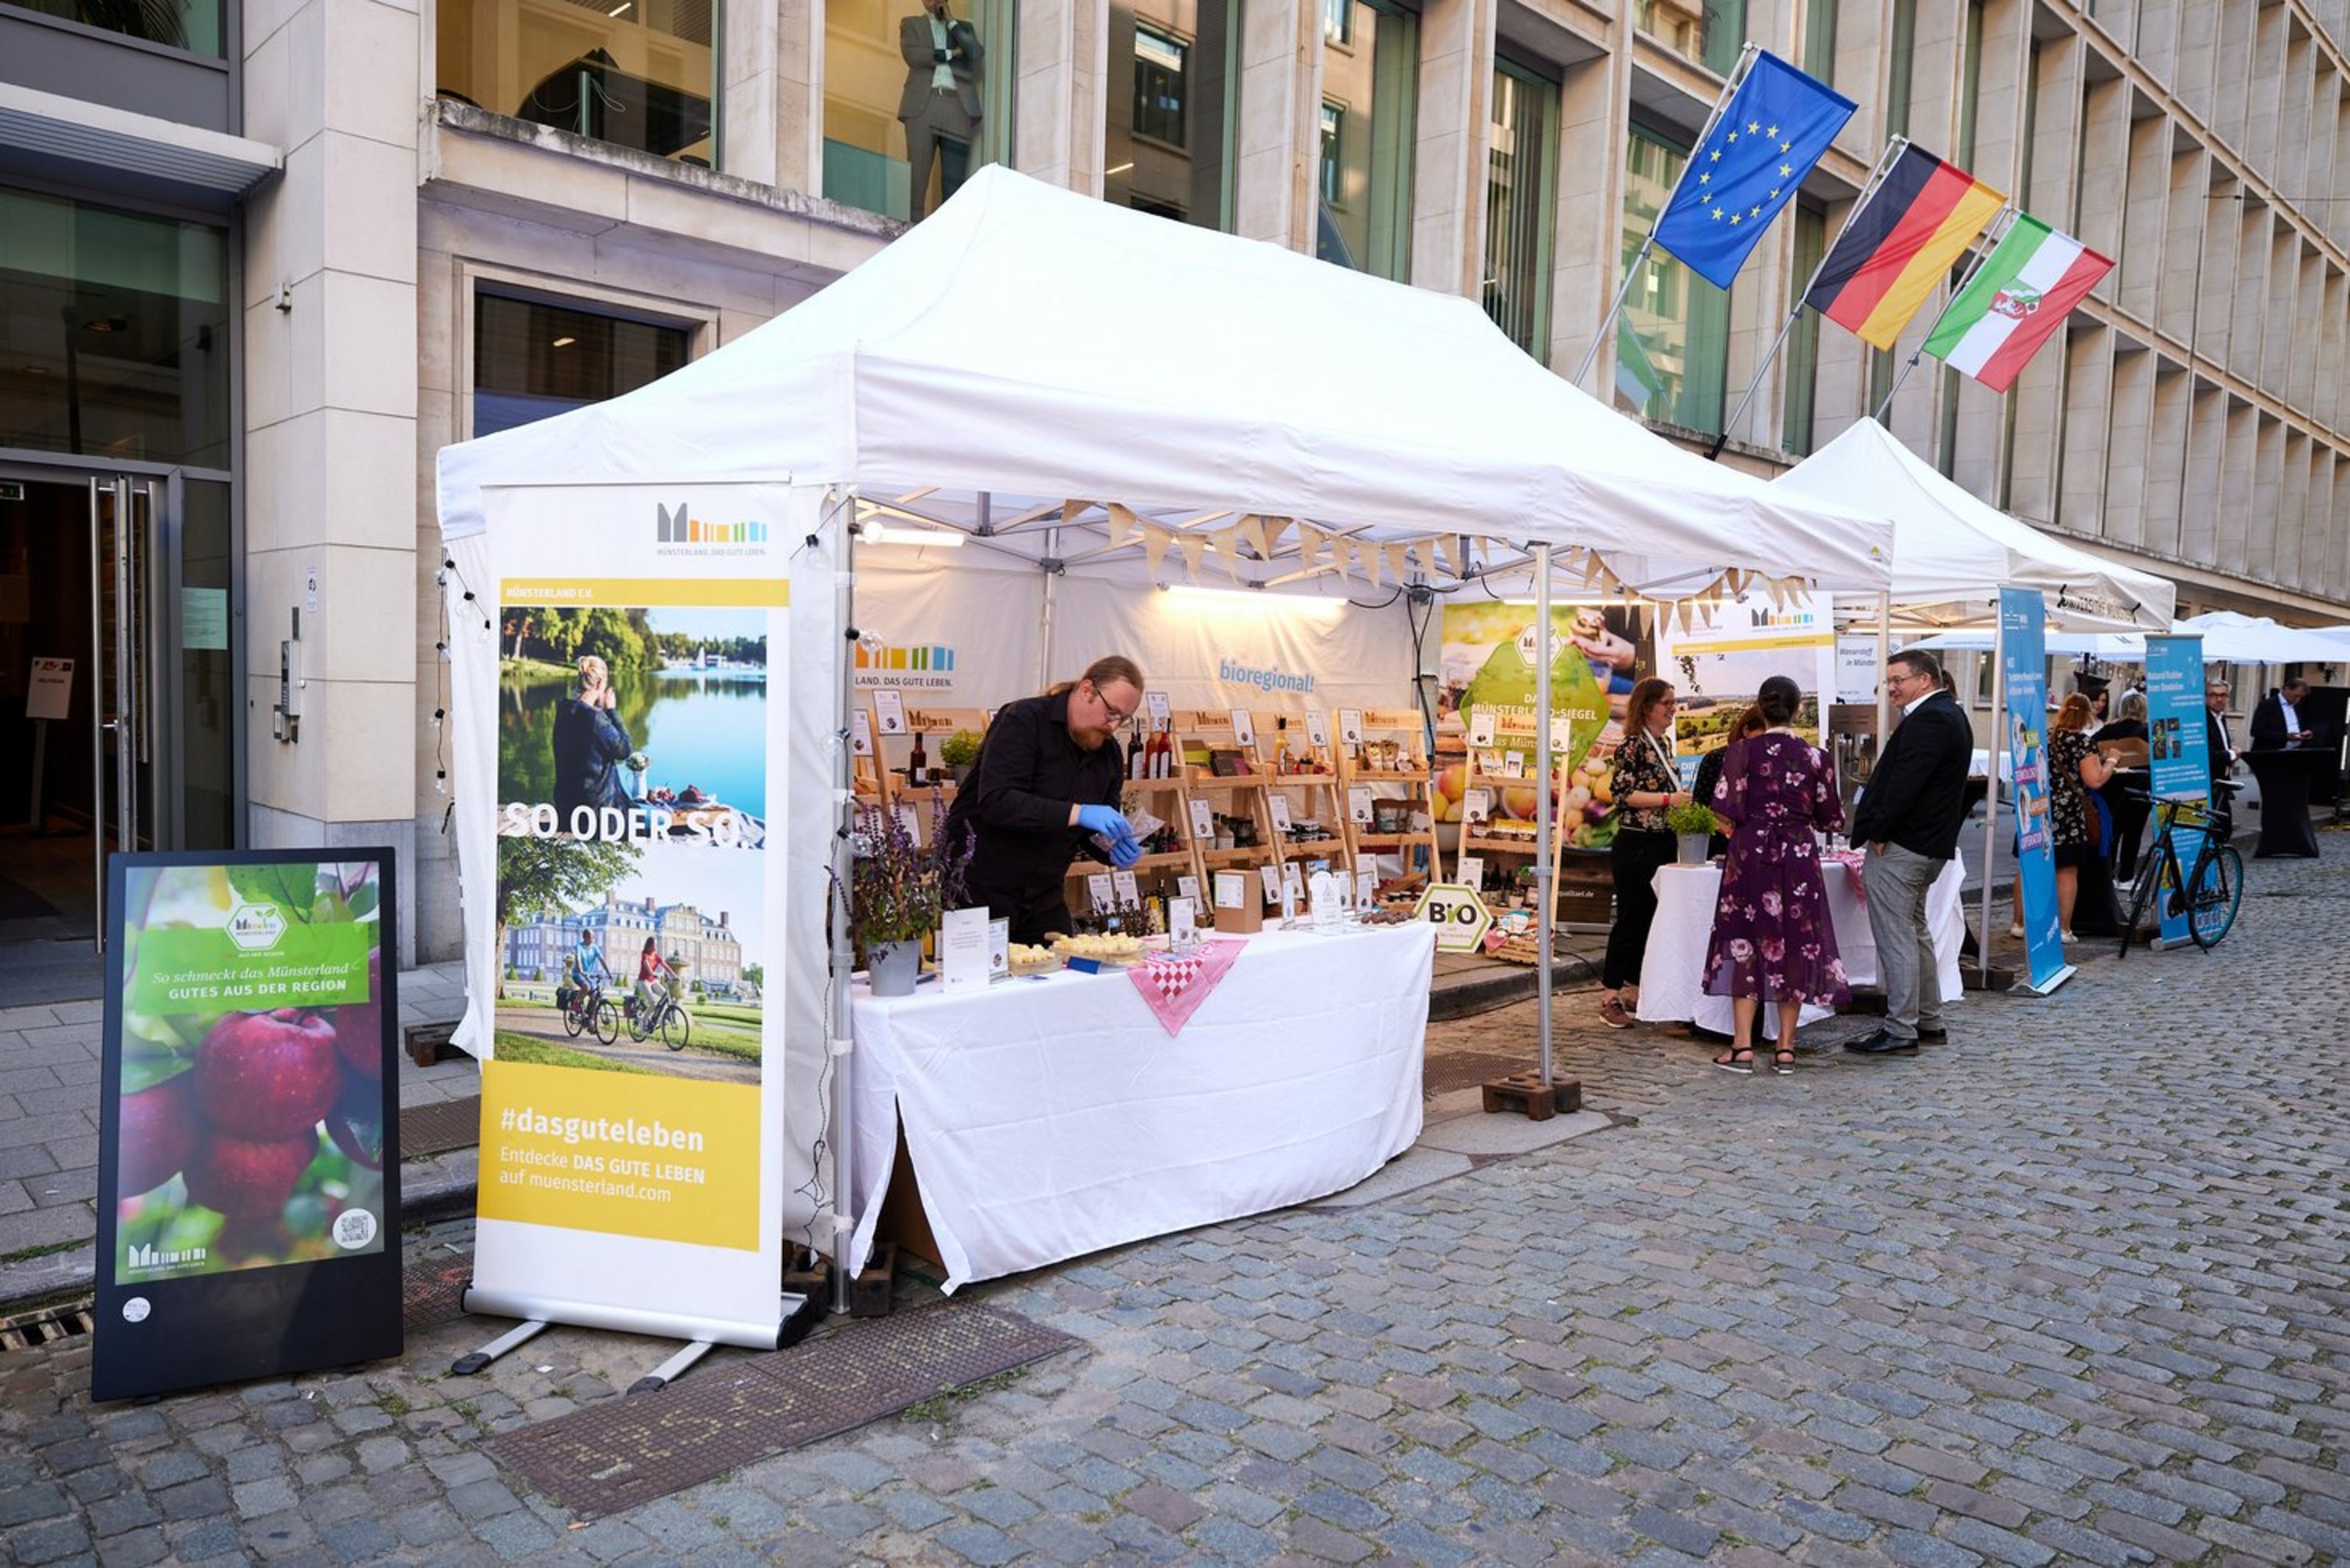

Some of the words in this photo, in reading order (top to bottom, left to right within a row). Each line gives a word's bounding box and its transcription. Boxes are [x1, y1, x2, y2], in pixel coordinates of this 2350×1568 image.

[506, 585, 576, 599] MÜNSTERLAND
[883, 676, 902, 685] DAS
[902, 677, 925, 687] GUTE
[1220, 658, 1315, 693] bioregional!
[1472, 699, 1597, 720] MÜNSTERLAD-SIEGEL
[1524, 693, 1538, 704] DA
[505, 802, 559, 839] SO
[571, 805, 673, 846] ODER
[153, 971, 170, 984] So
[173, 967, 236, 983] schmeckt
[239, 966, 264, 979] das
[267, 962, 350, 978] Münsterland
[168, 986, 219, 1000] GUTES
[223, 983, 253, 997] AUS
[258, 980, 287, 994] DER
[292, 979, 347, 993] REGION
[499, 1106, 704, 1152] #dasguteleben
[500, 1146, 568, 1167] Entdecke
[573, 1154, 604, 1173] DAS
[609, 1158, 651, 1178] GUTE
[655, 1164, 705, 1185] LEBEN
[499, 1168, 525, 1185] auf
[529, 1172, 672, 1203] muensterland.com
